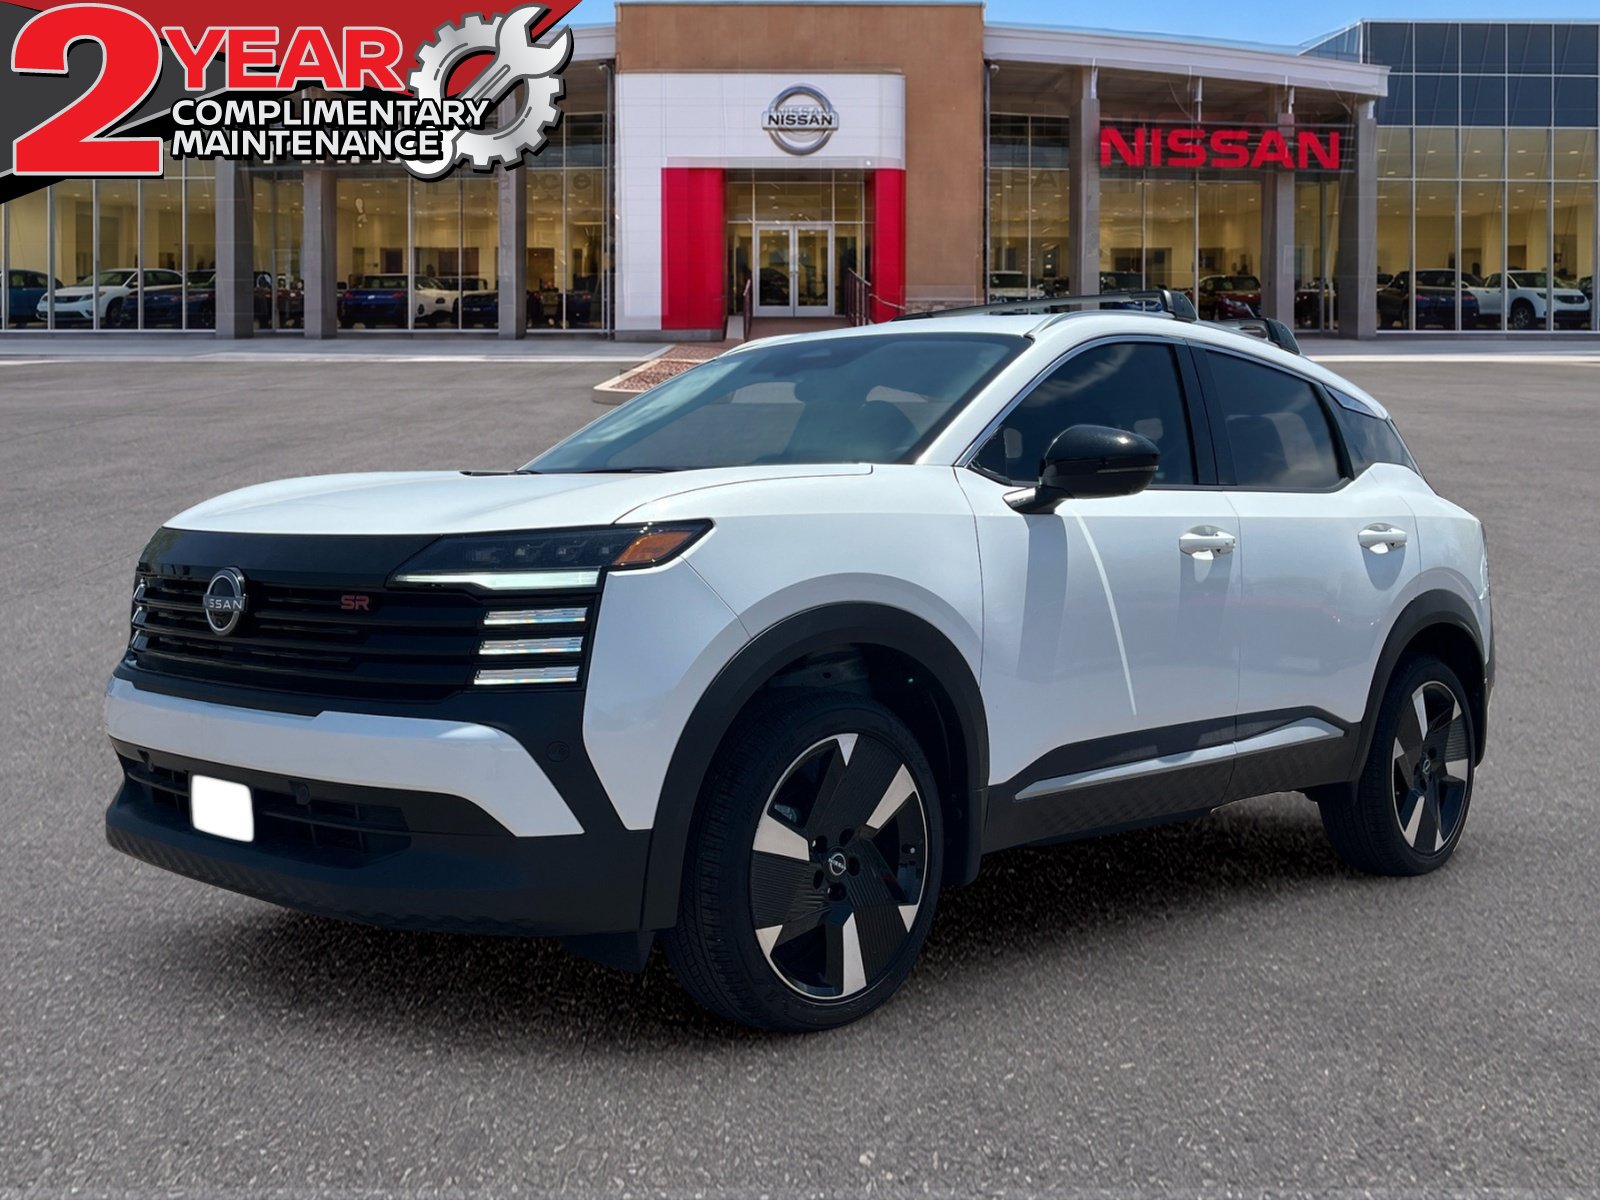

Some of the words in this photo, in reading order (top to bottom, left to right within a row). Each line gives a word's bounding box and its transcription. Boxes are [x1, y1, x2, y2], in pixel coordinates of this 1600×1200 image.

[767, 114, 833, 126] NISSAN
[1099, 127, 1340, 169] NISSAN
[204, 598, 243, 609] SSAN
[340, 595, 369, 611] SR
